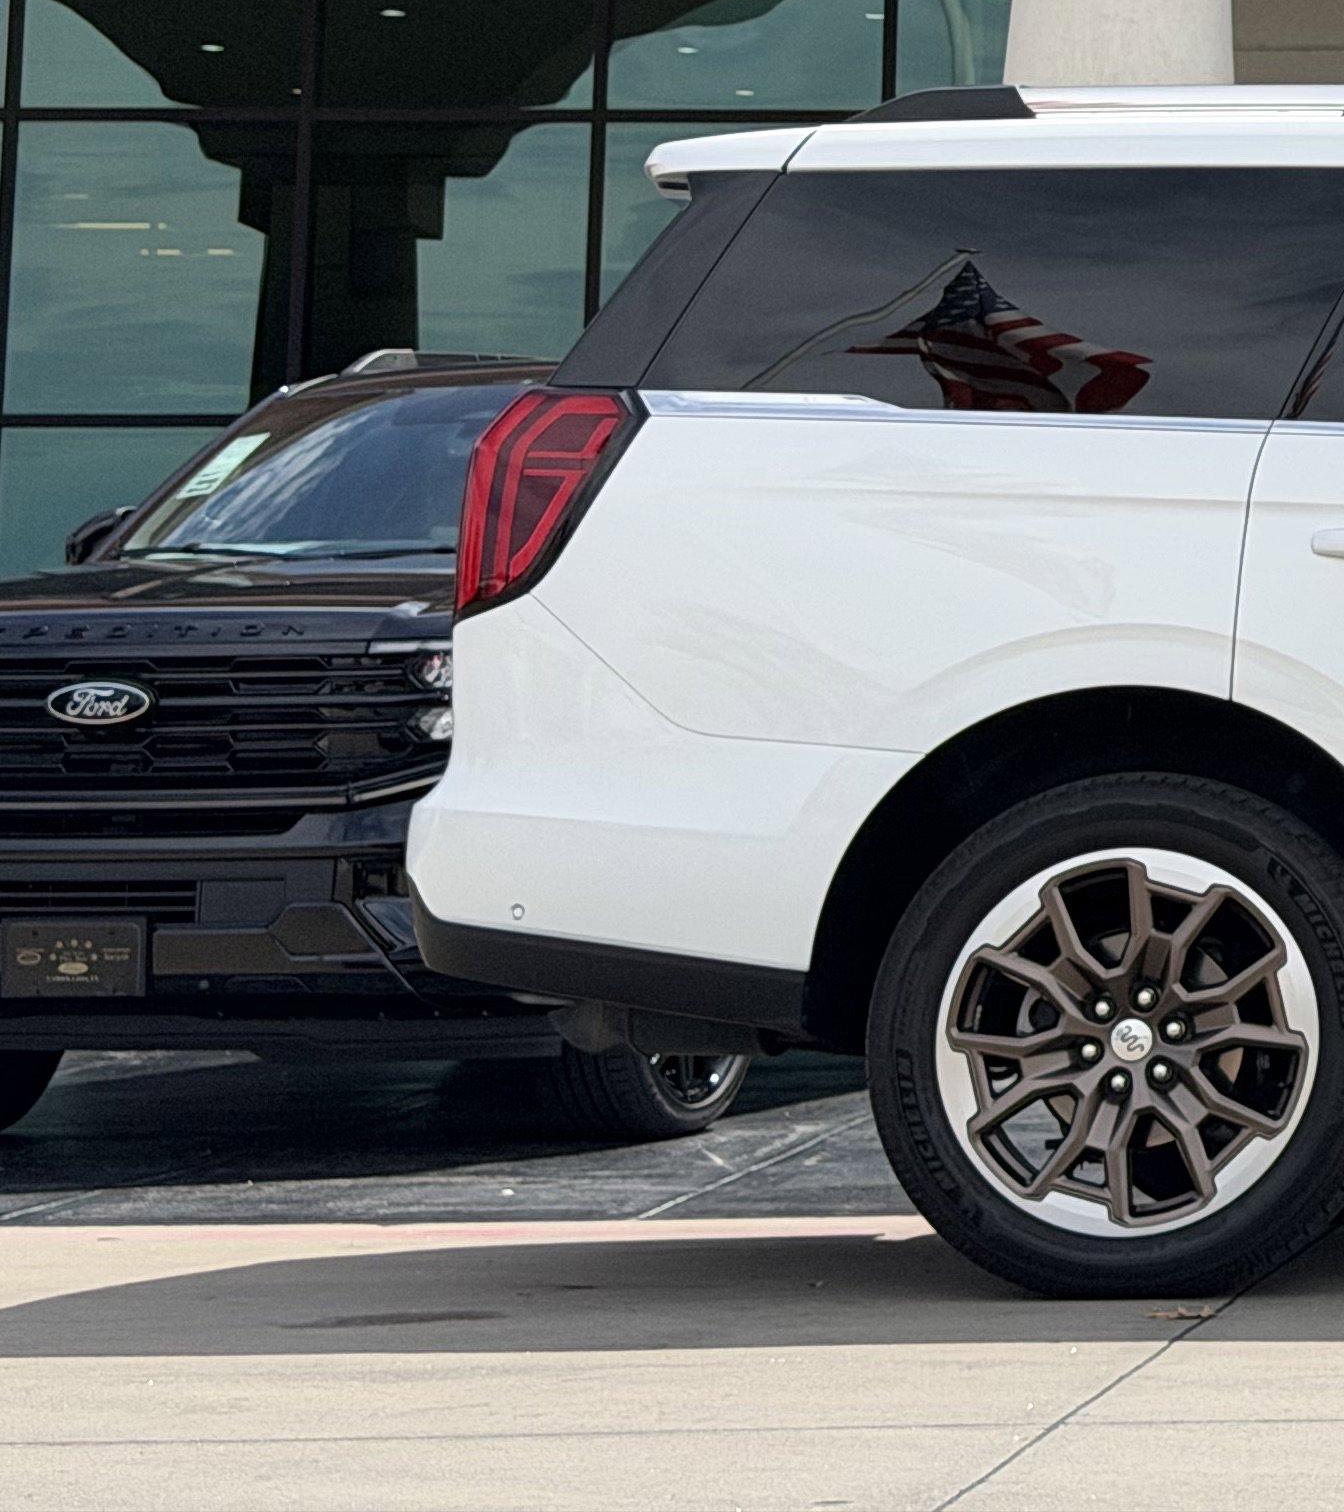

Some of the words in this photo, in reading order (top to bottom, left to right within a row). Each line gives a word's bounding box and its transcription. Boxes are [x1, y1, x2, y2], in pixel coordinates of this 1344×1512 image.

[0, 621, 305, 639] PEDITION
[65, 687, 129, 717] Ford
[897, 1054, 956, 1192] MICHELIN
